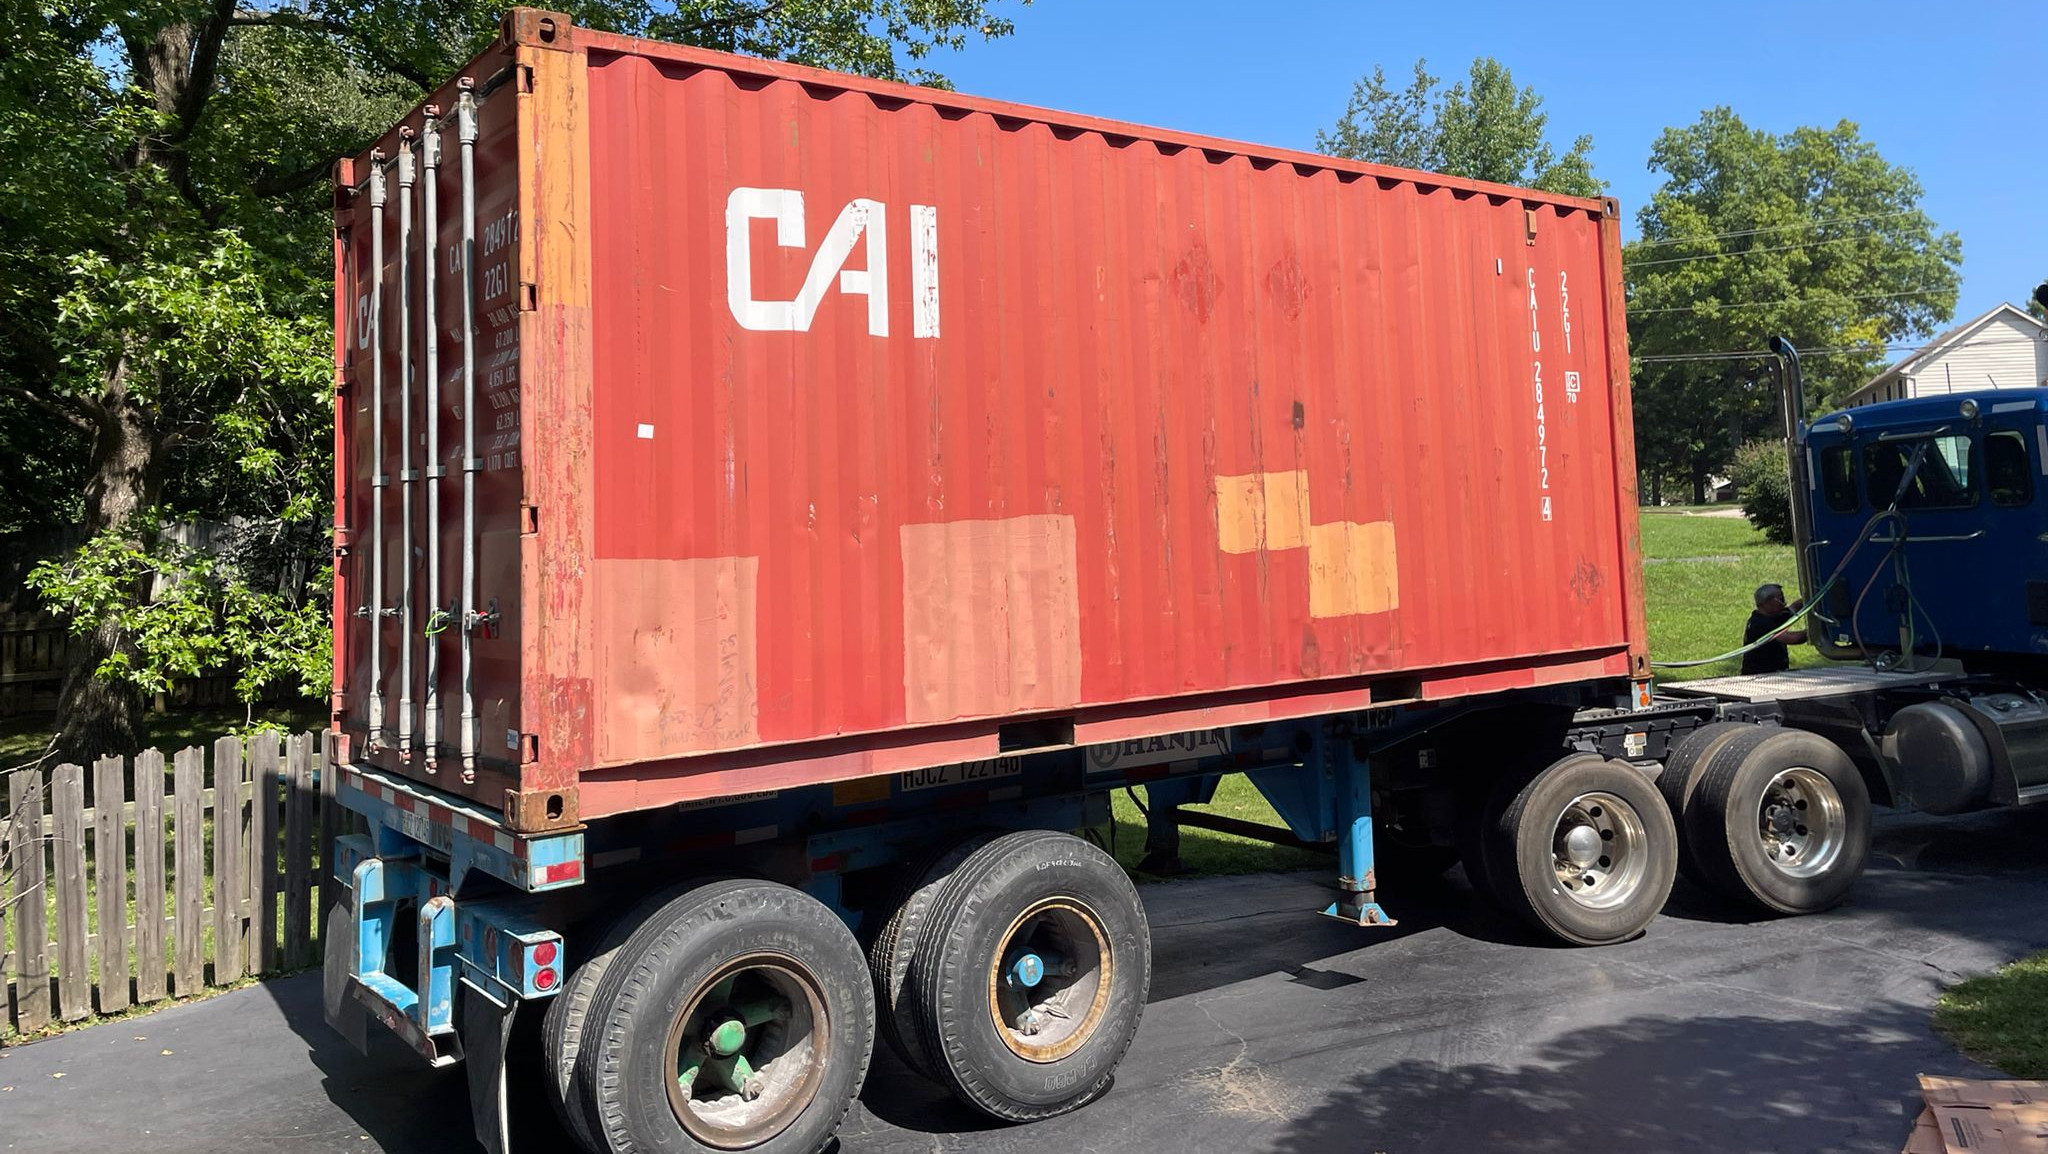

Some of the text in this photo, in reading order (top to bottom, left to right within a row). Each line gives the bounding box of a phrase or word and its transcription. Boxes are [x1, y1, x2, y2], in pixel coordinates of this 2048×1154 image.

[484, 261, 508, 301] 22G1
[725, 186, 940, 339] CAI
[1560, 271, 1571, 353] 22G1
[1528, 267, 1551, 518] CAIU 284972 4
[1567, 391, 1577, 404] 70
[1123, 726, 1227, 757] HANJIN
